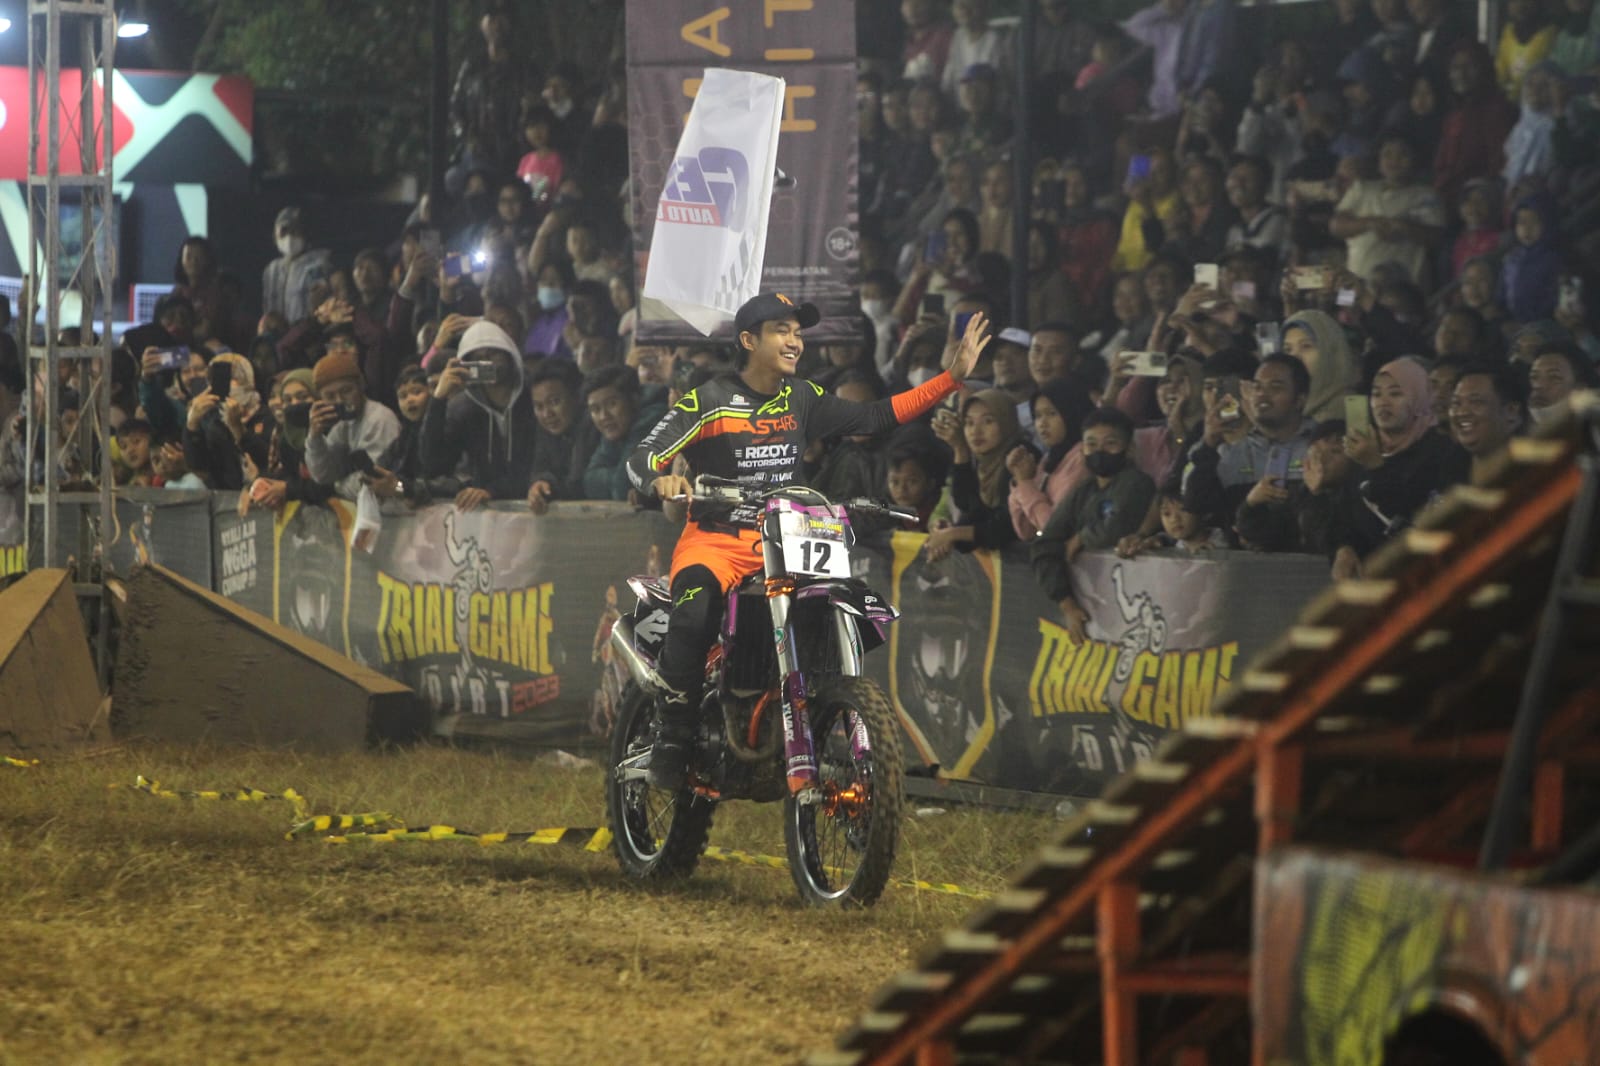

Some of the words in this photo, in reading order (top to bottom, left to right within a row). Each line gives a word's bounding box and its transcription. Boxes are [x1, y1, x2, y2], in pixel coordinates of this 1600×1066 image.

[737, 457, 796, 469] MOTORSPORT
[800, 540, 831, 574] 12
[376, 570, 460, 664] TRIAL
[469, 582, 555, 675] GAME
[1029, 616, 1120, 718] TRIAL
[511, 674, 560, 714] 2023
